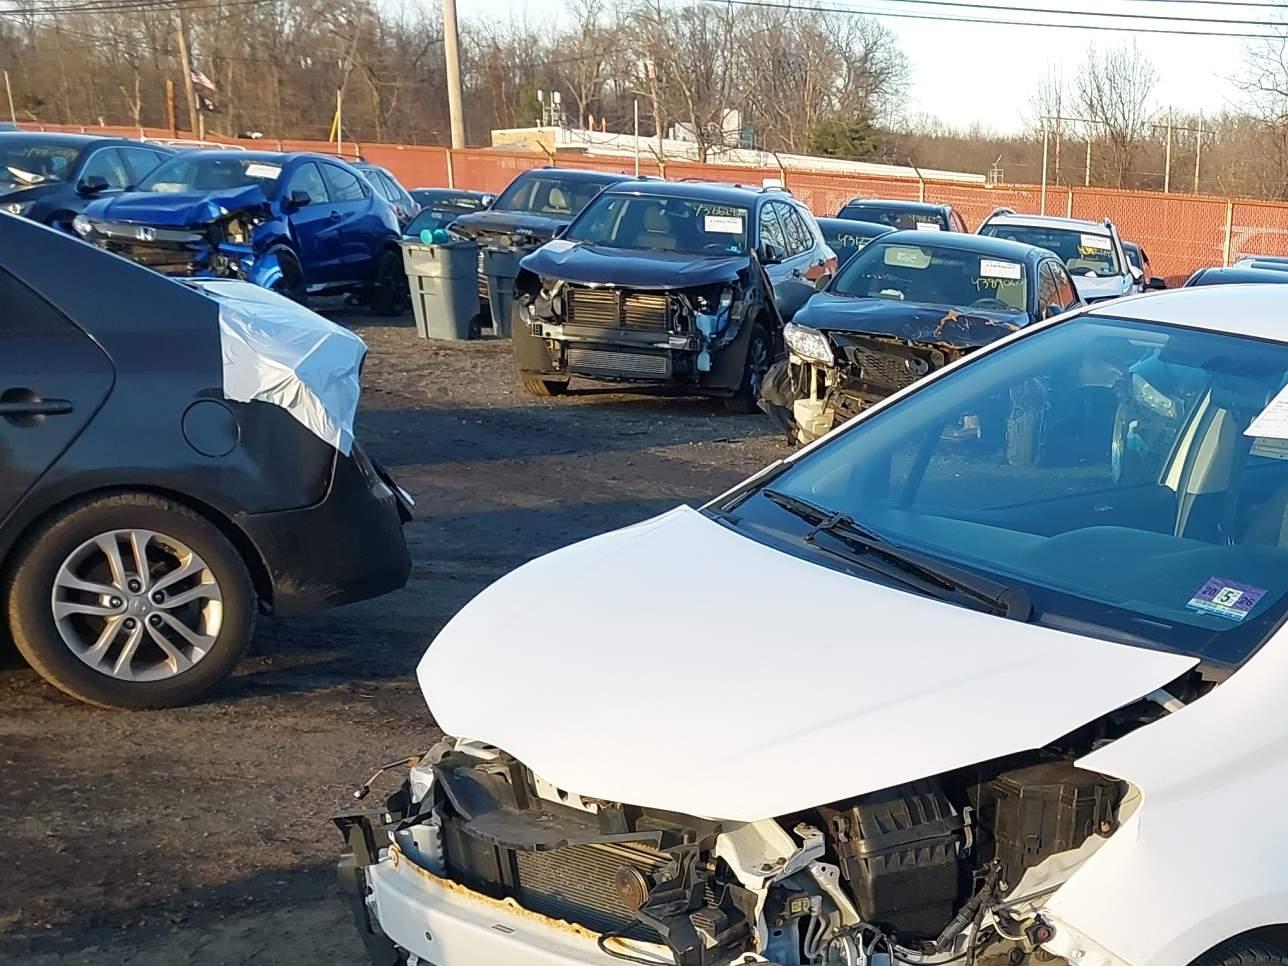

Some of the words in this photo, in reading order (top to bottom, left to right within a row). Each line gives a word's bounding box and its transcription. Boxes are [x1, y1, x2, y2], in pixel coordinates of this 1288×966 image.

[1202, 587, 1217, 597] 20
[1221, 591, 1234, 603] 5
[1240, 596, 1255, 607] 26
